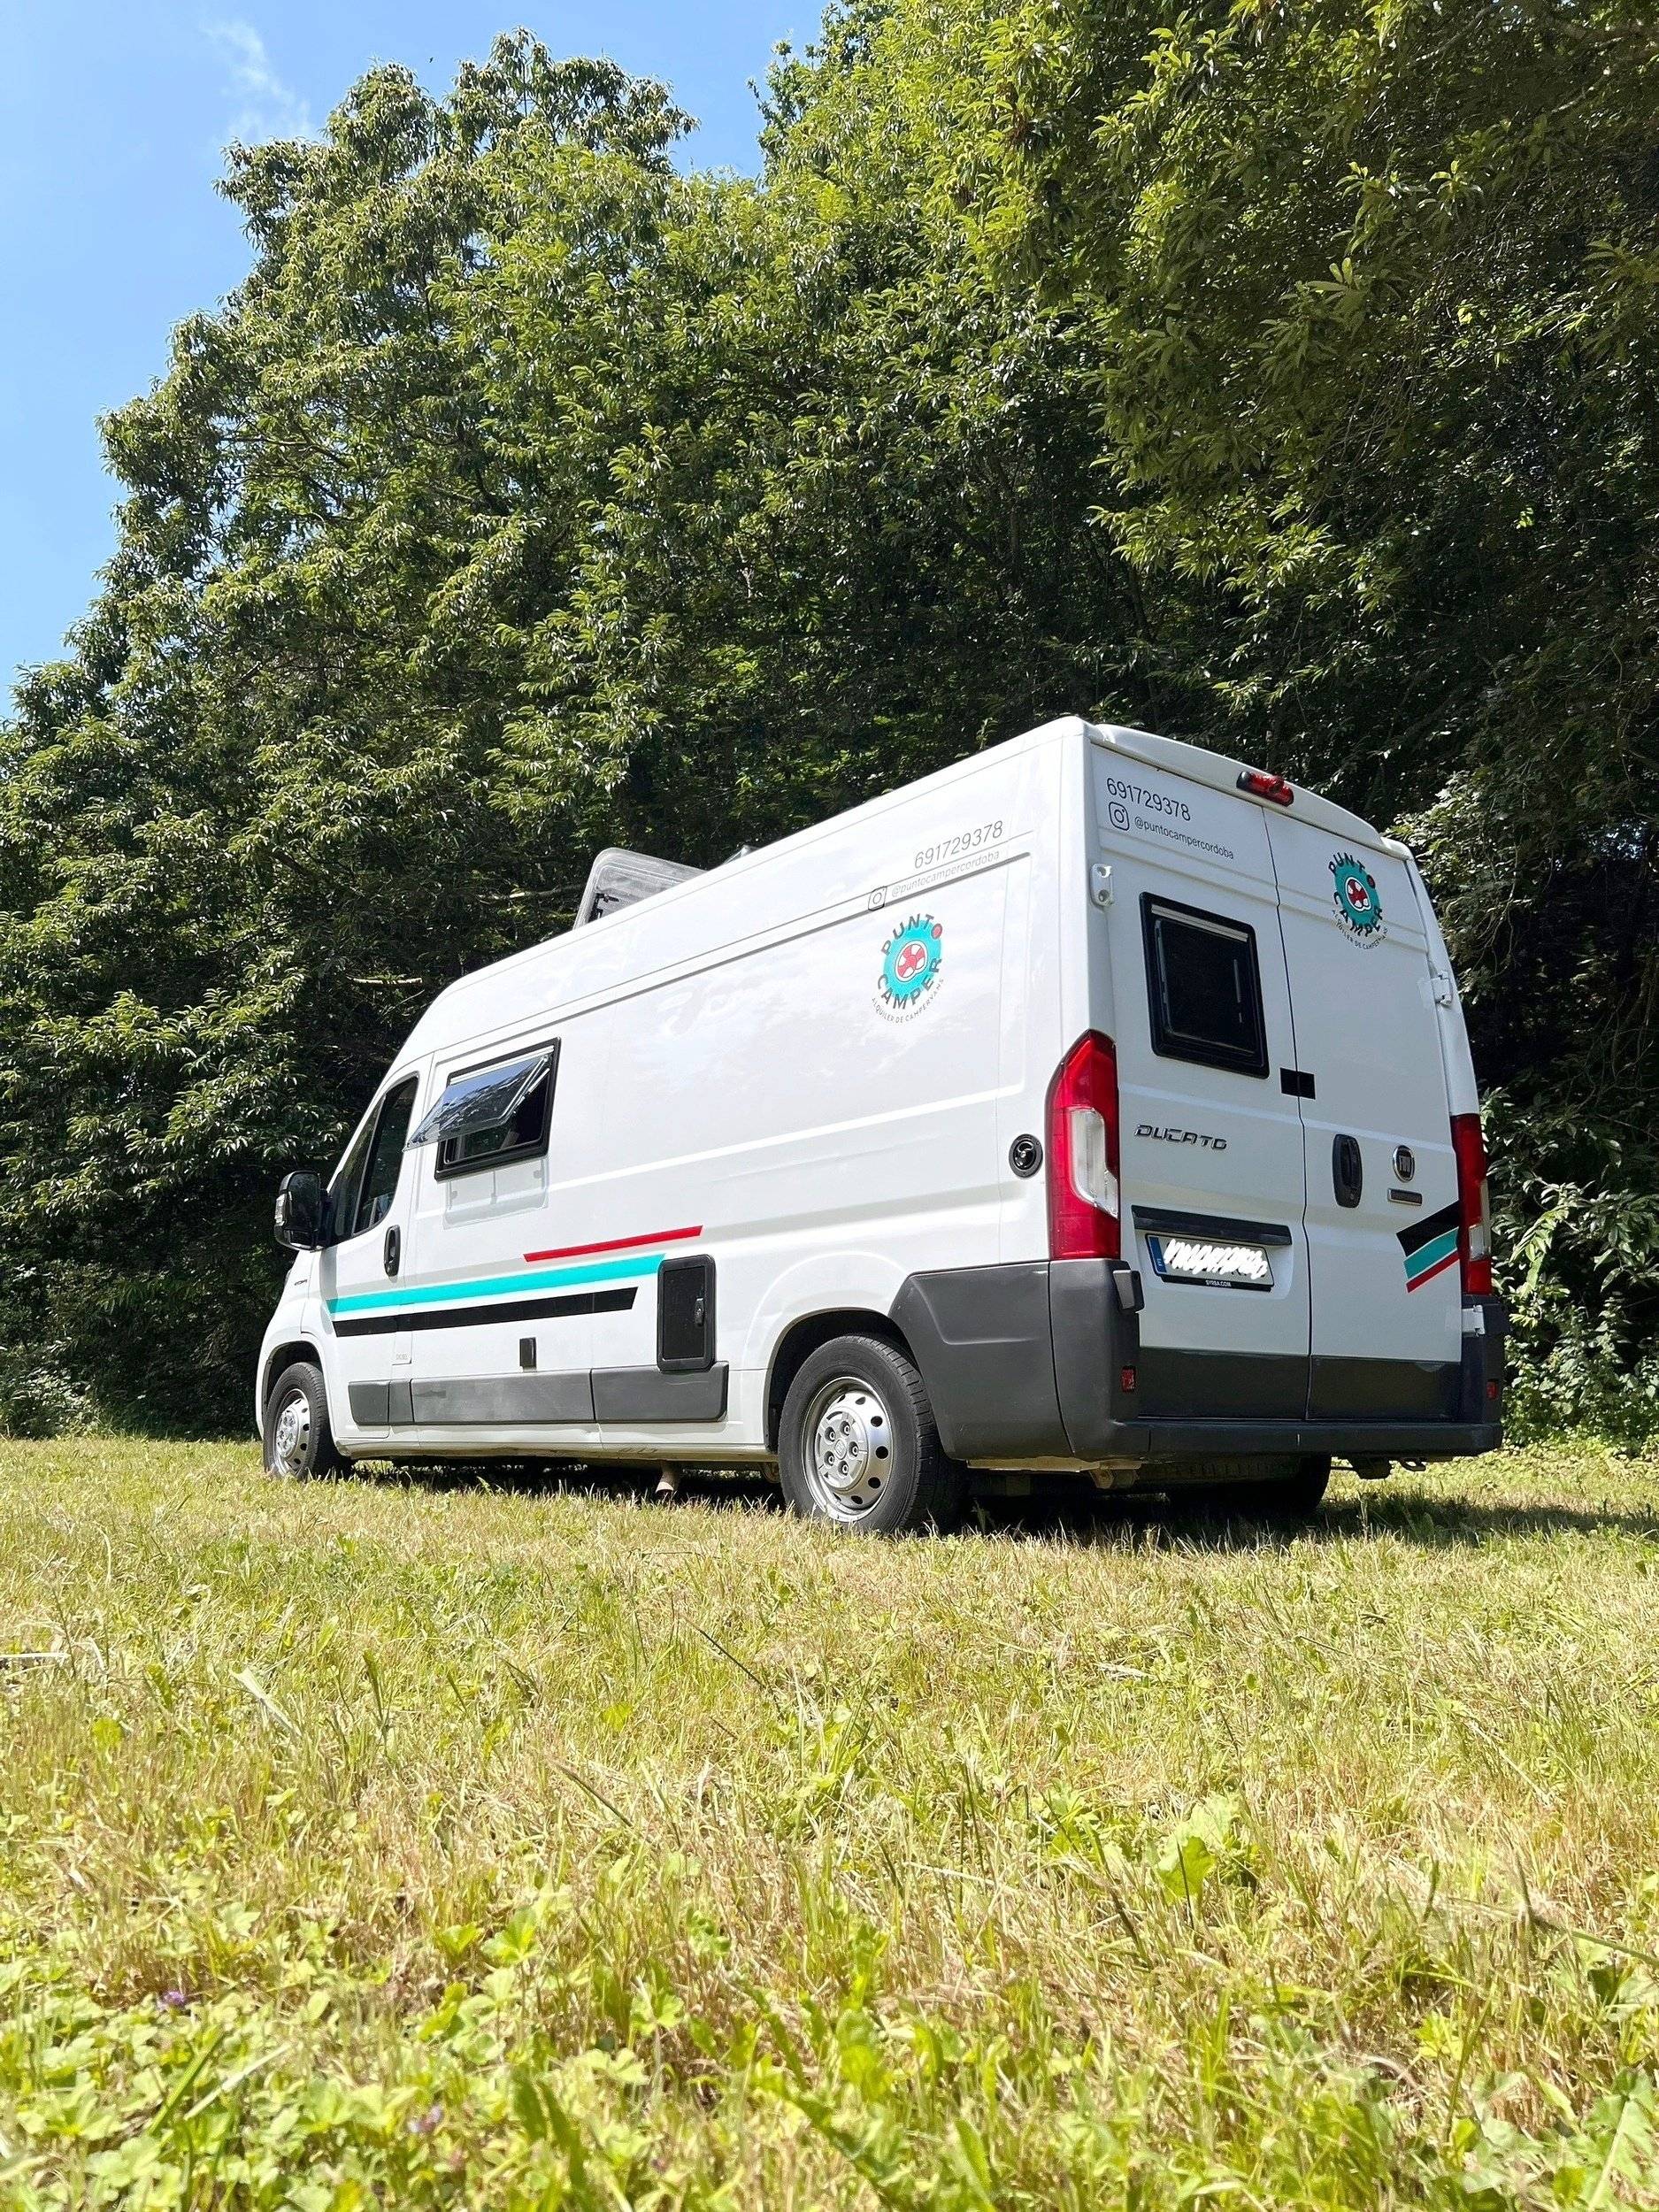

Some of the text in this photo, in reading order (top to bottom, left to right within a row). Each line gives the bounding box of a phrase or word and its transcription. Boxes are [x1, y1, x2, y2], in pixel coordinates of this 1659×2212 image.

[1106, 777, 1191, 822] 691729378
[914, 820, 1003, 869] 691729378
[1134, 816, 1234, 860] @puntocampercordoba
[891, 850, 1000, 898] @puntocampercordoba
[1333, 891, 1383, 938] CAMPER
[872, 997, 895, 1023] ALQUILER
[905, 978, 944, 1022] CAMPERVANS
[877, 957, 942, 1010] CAMPER
[1134, 1123, 1227, 1151] DUCATO
